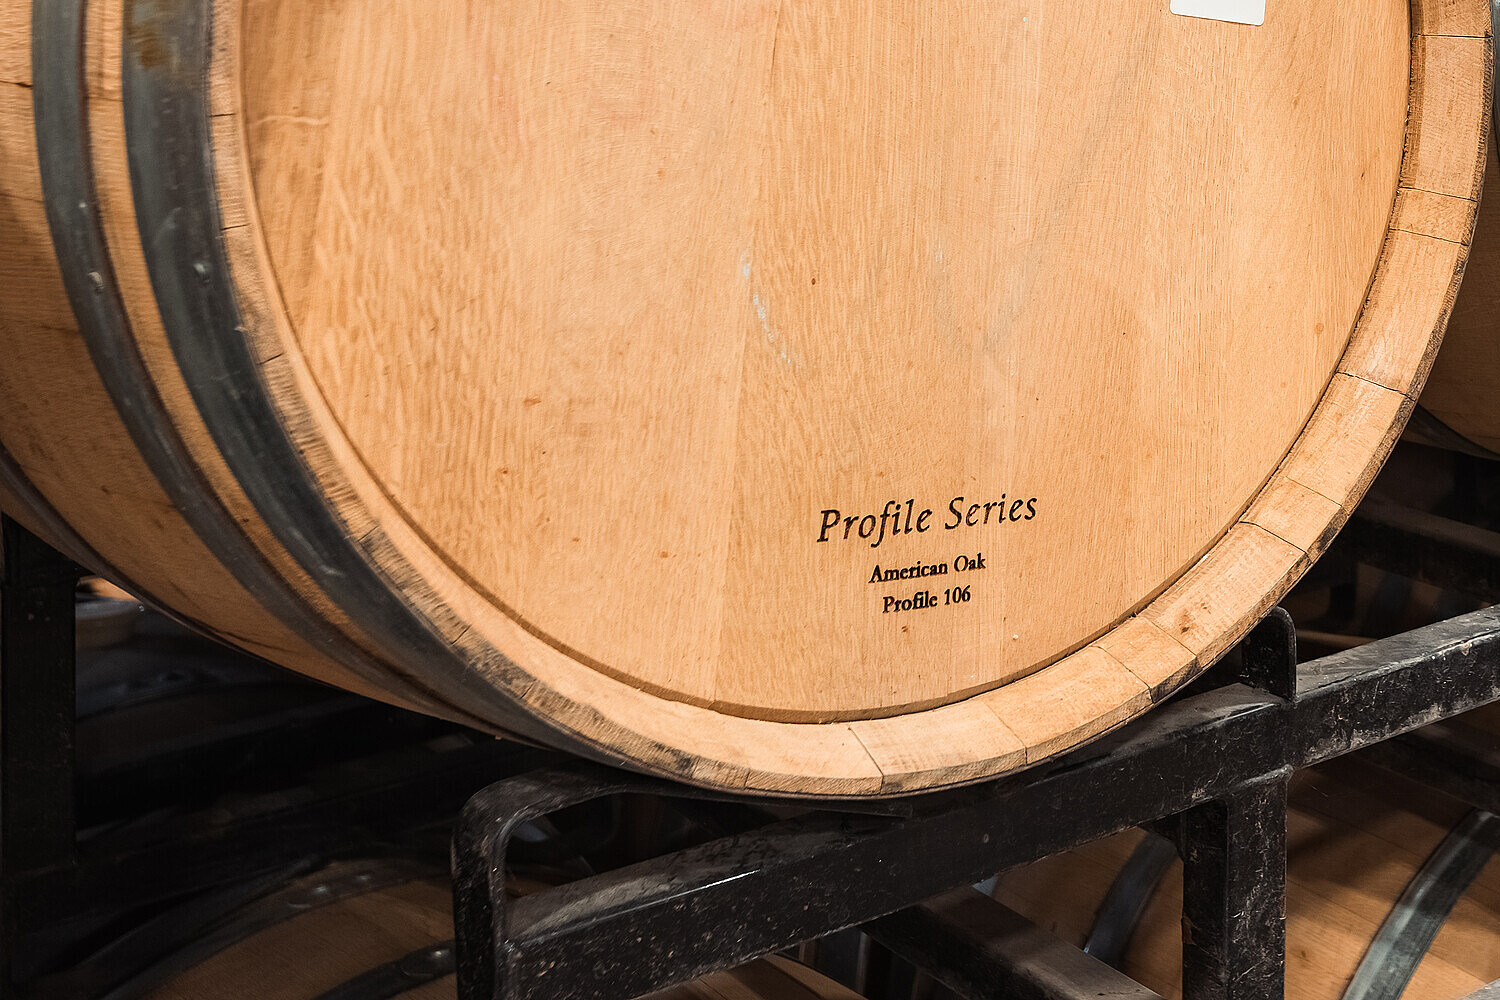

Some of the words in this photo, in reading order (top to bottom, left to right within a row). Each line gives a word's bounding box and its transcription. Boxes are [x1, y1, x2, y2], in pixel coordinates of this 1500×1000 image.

[816, 498, 933, 548] Profile
[944, 493, 1038, 530] Series
[868, 560, 948, 584] American
[954, 552, 987, 572] Oak
[882, 590, 938, 614] Profile
[943, 584, 971, 605] 106
